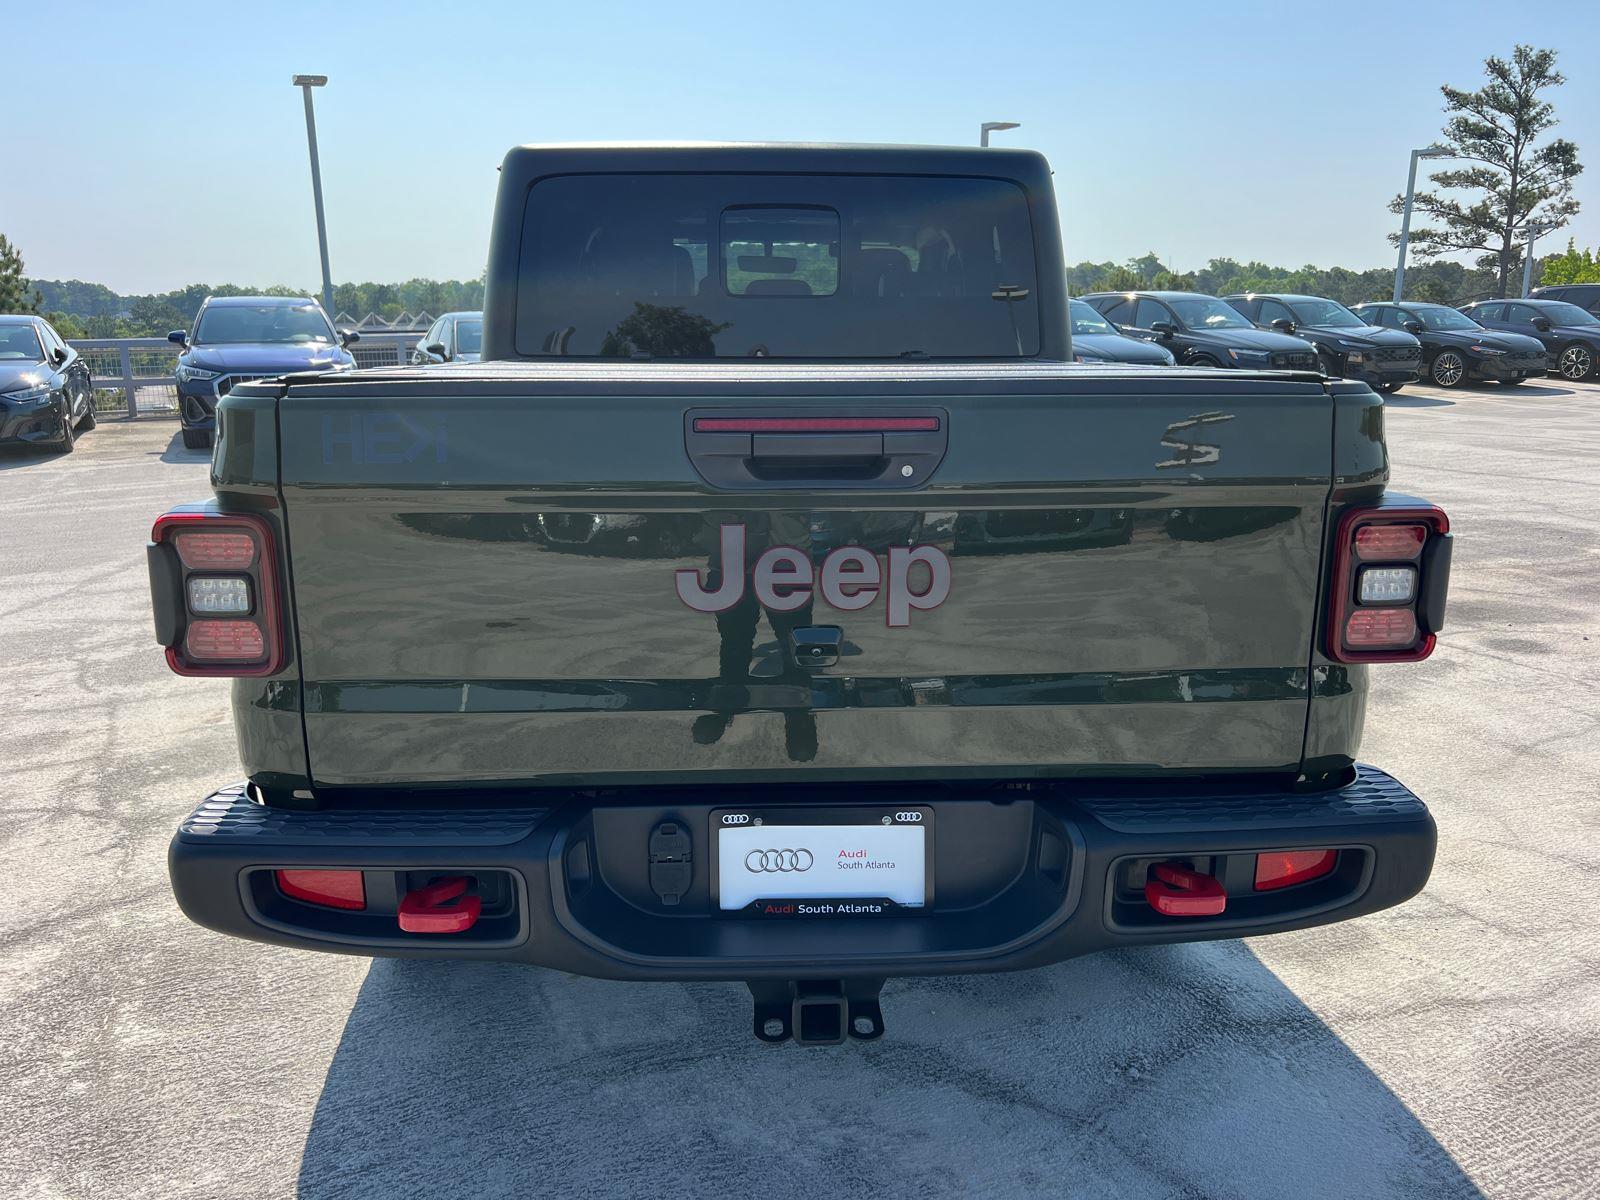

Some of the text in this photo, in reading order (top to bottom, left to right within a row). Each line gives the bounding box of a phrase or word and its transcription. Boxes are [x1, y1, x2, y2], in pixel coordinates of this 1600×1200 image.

[675, 523, 951, 627] Jeep
[838, 849, 868, 858] Audi
[837, 860, 896, 870] South Atlanta
[764, 903, 882, 914] Audi South Atlanta
